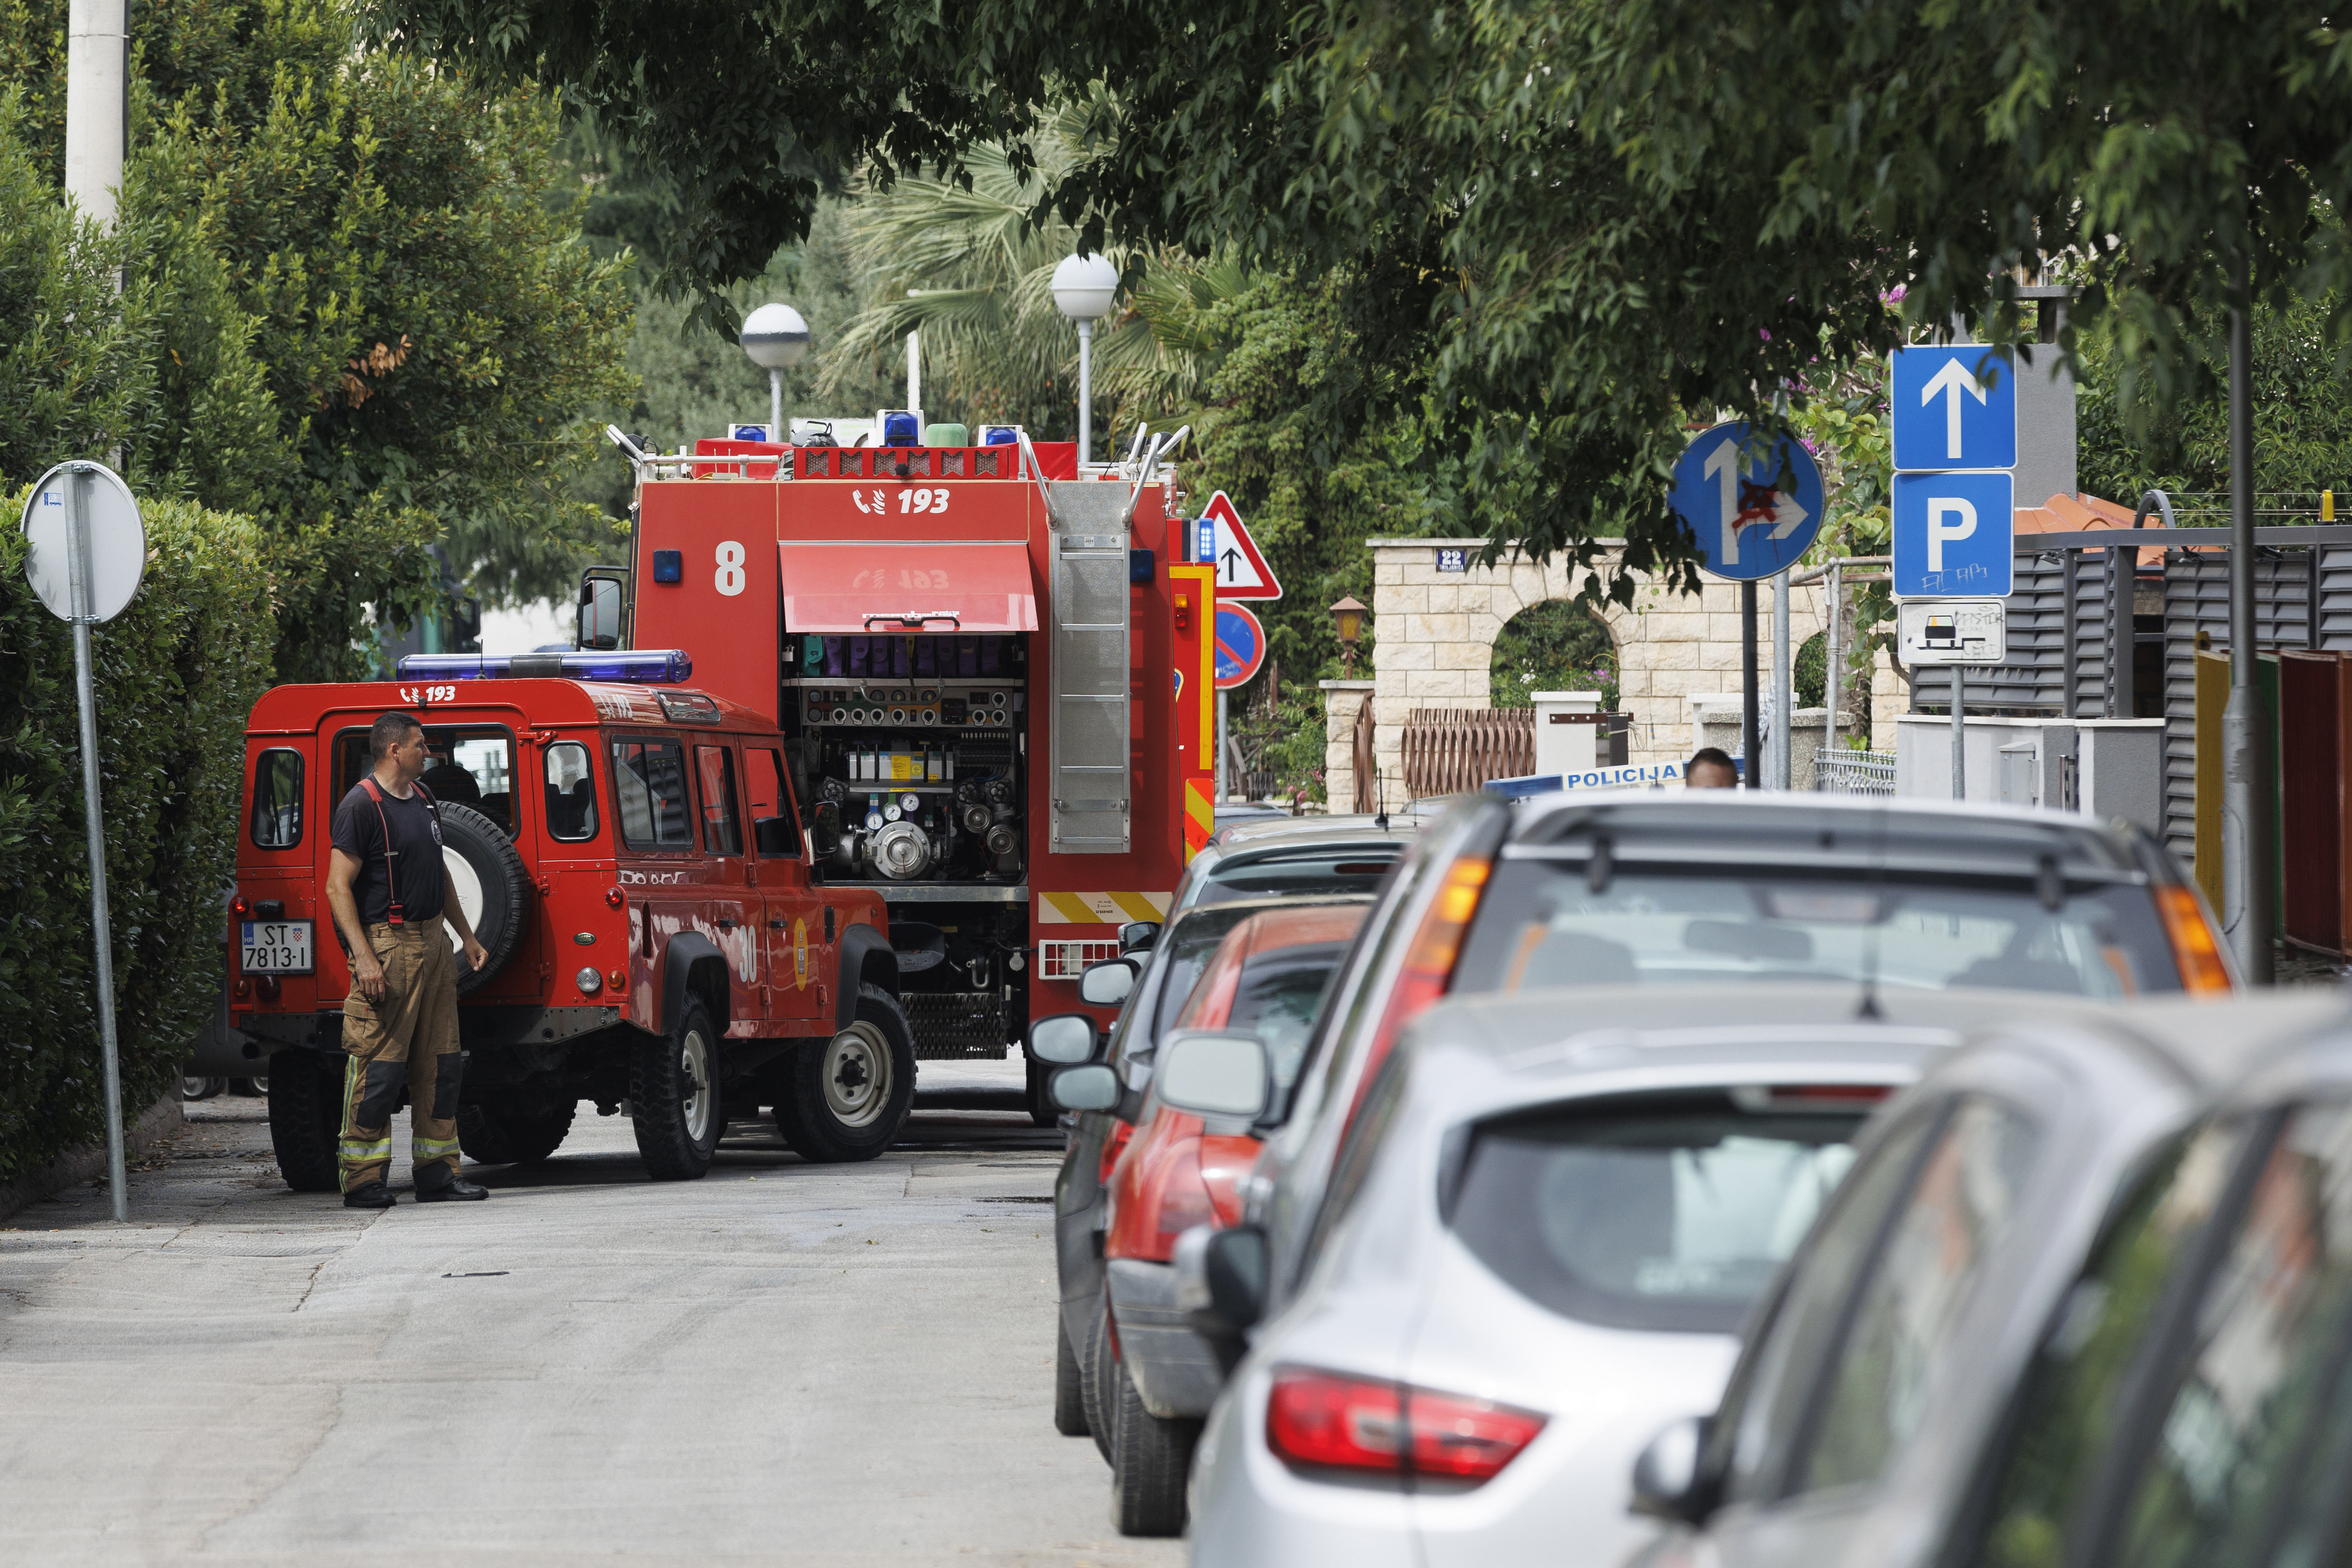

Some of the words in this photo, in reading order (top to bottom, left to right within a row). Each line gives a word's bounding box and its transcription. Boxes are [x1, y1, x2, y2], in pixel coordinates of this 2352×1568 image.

[898, 489, 950, 513] 193
[1928, 498, 1977, 572] P
[715, 541, 745, 596] 8
[1442, 550, 1461, 565] 22
[426, 686, 456, 702] 193
[1567, 765, 1678, 789] POLICIJA
[264, 925, 288, 945] ST
[739, 925, 757, 982] 30
